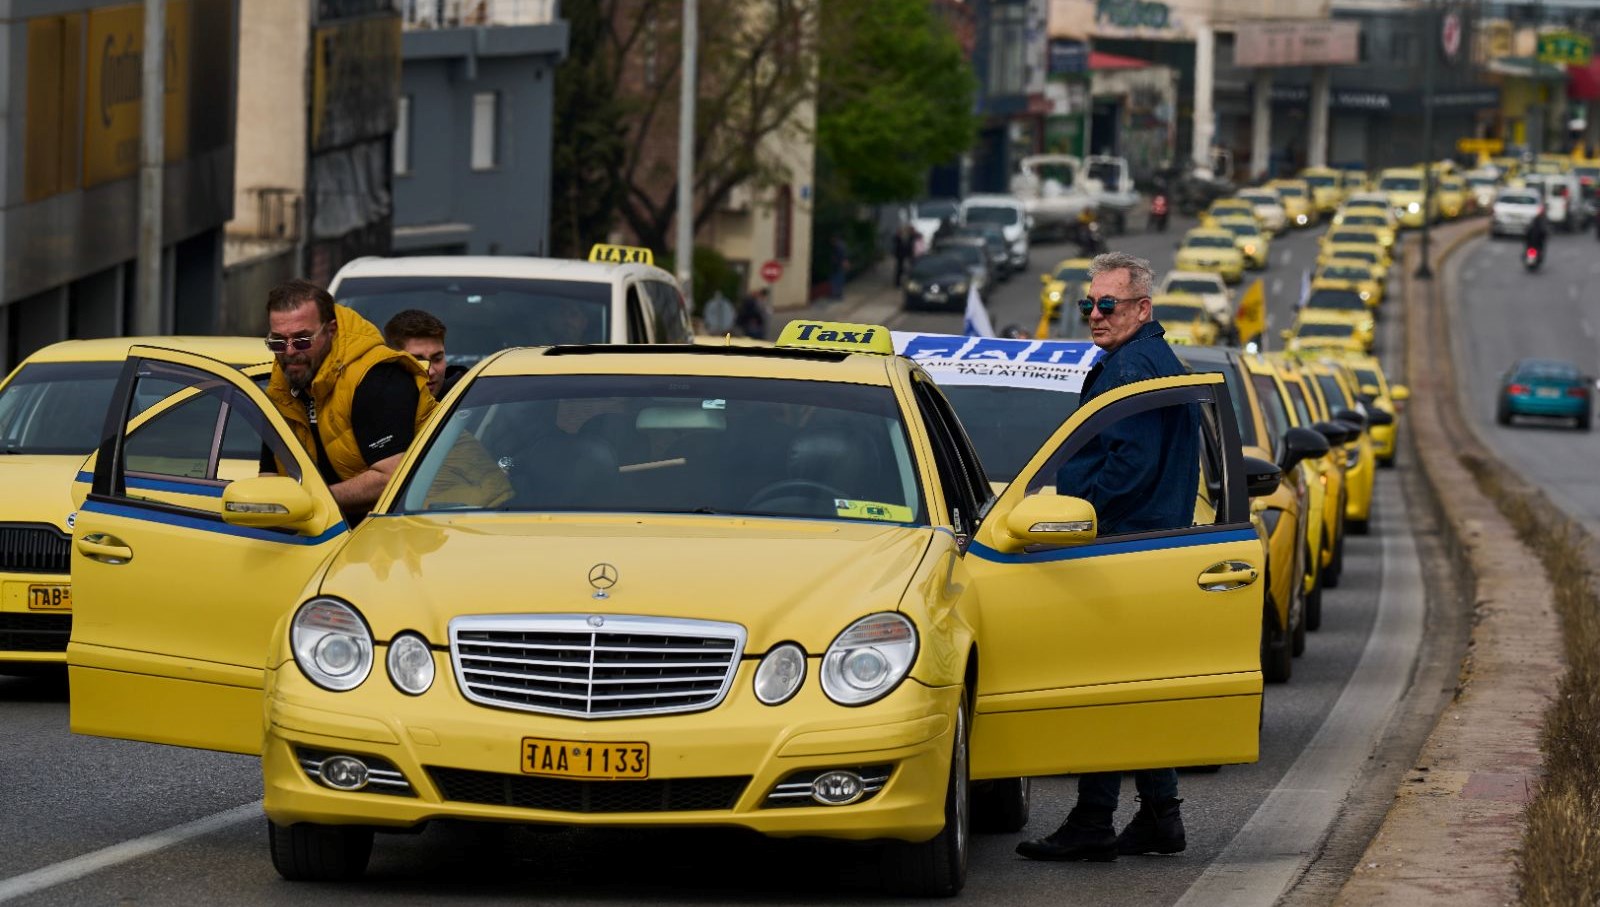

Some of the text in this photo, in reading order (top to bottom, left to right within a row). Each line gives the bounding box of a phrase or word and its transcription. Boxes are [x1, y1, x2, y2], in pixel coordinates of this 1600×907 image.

[598, 246, 647, 263] TAXI
[797, 323, 876, 344] Taxi
[992, 364, 1087, 375] ΑΥΤΟΚΙΝΗΤ
[585, 747, 644, 773] 1133
